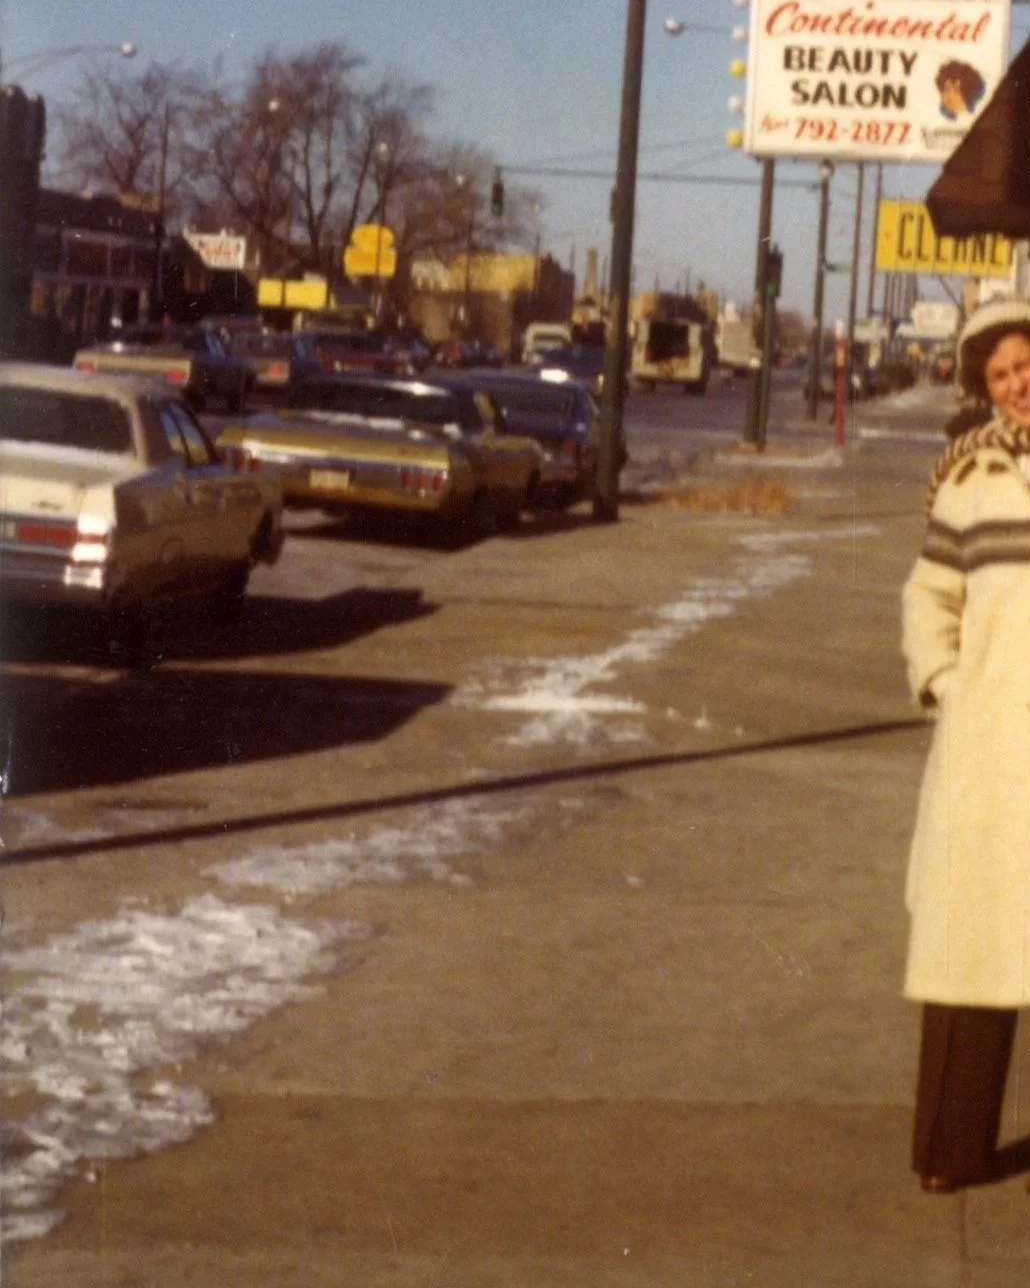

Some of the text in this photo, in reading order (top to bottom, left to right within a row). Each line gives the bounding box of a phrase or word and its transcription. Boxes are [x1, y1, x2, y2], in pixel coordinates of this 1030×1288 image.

[764, 0, 992, 44] Continental
[782, 45, 919, 77] BEAUTY
[790, 77, 907, 109] SALON
[793, 116, 912, 145] 792-2877
